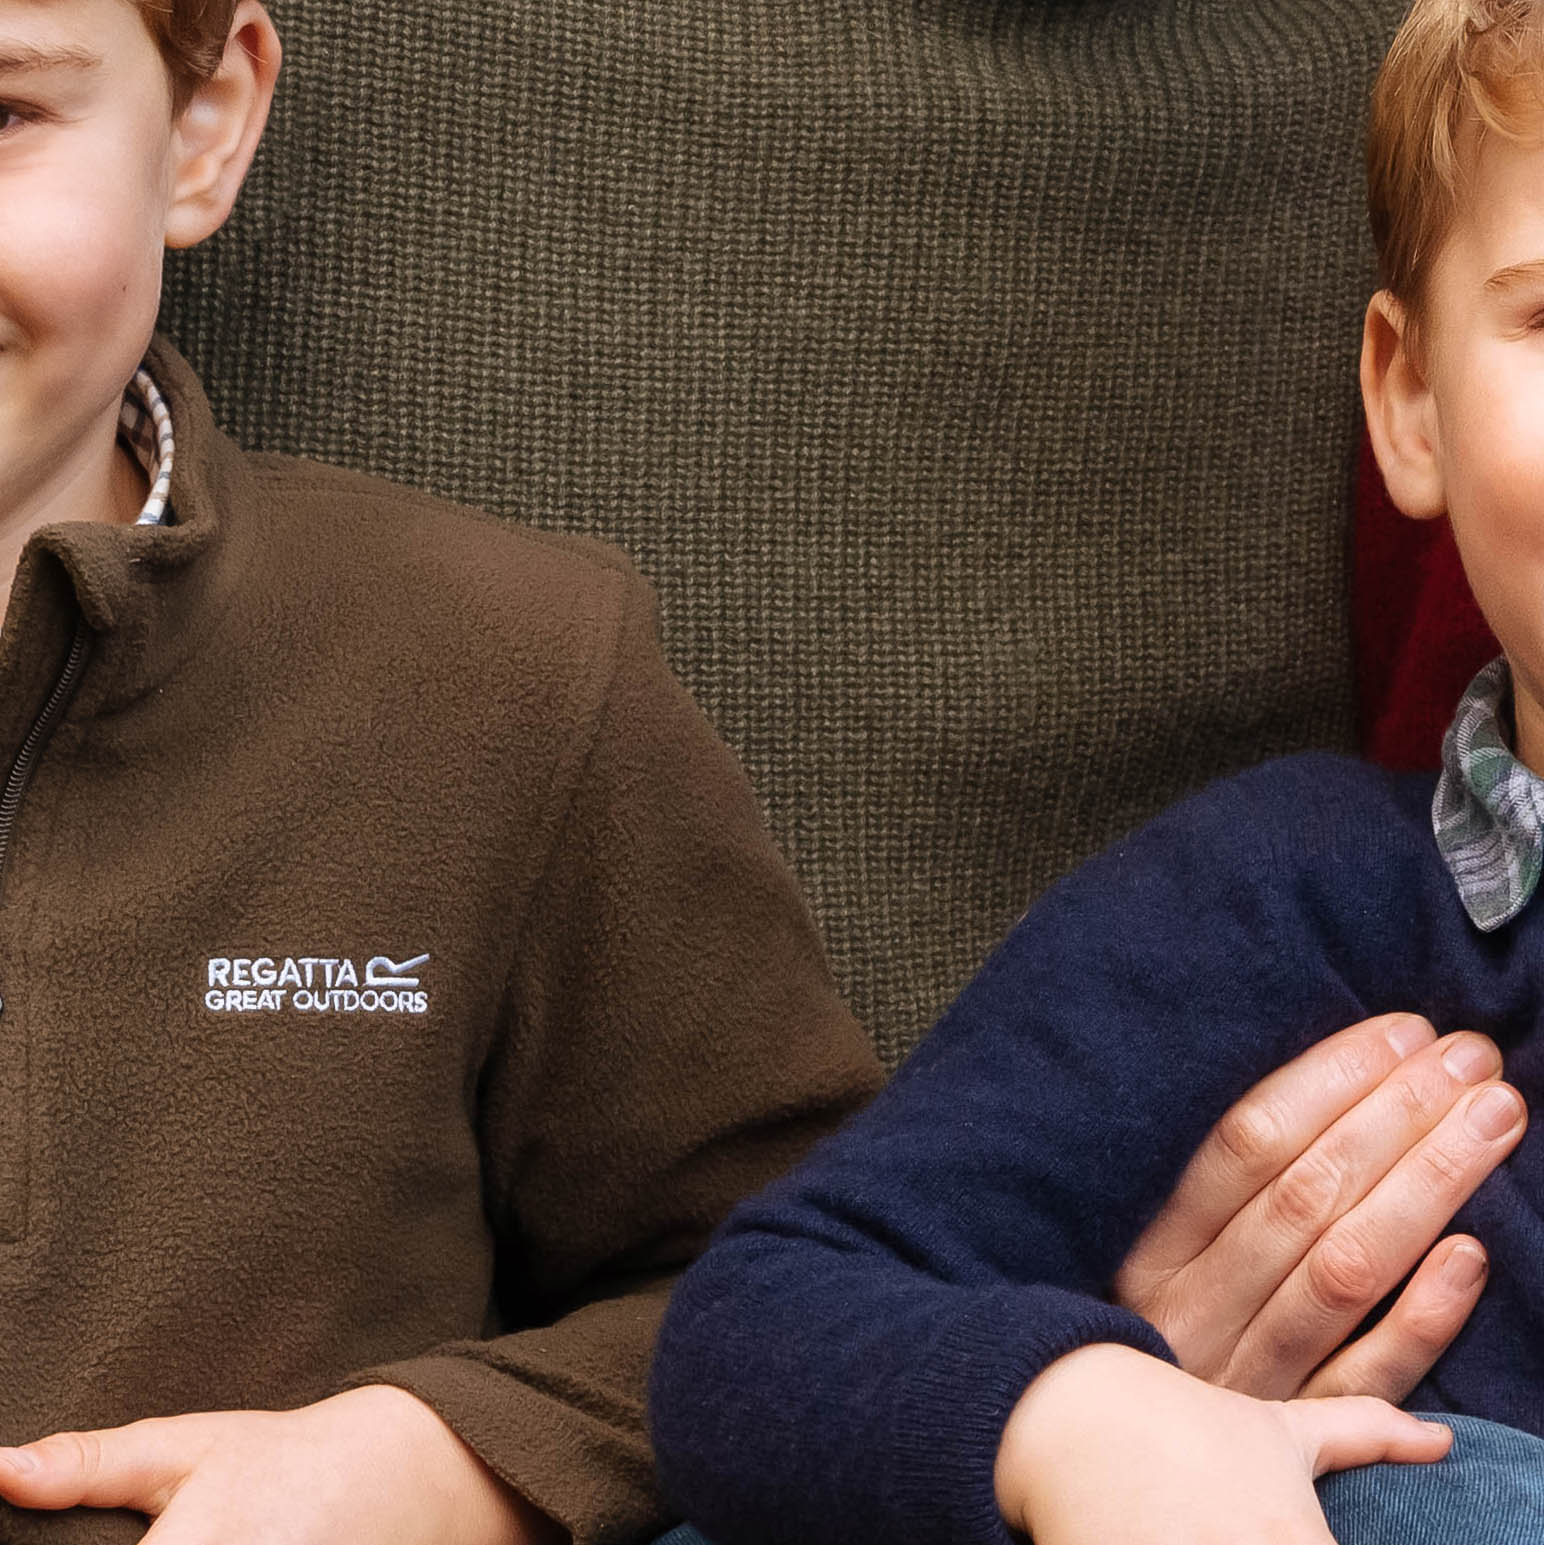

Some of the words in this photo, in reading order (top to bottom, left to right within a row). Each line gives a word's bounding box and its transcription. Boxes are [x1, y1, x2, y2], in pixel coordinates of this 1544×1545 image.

[208, 957, 358, 988] REGATTA
[205, 989, 287, 1011] GREAT
[292, 989, 428, 1013] OUTDOORS
